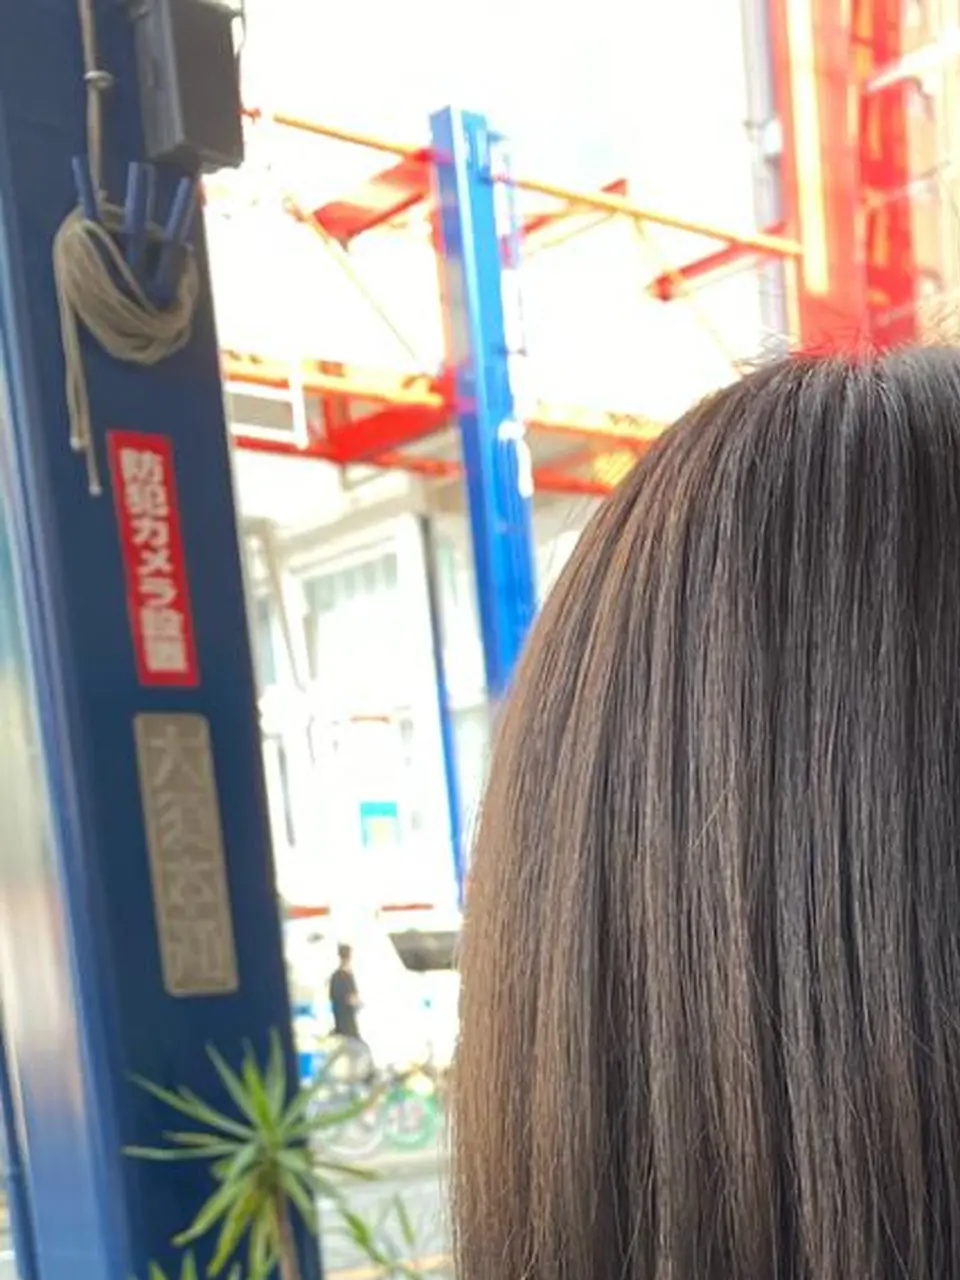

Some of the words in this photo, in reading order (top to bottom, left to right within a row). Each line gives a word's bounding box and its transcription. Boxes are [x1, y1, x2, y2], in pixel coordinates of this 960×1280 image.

[119, 446, 189, 673] 防犯カメラ設置
